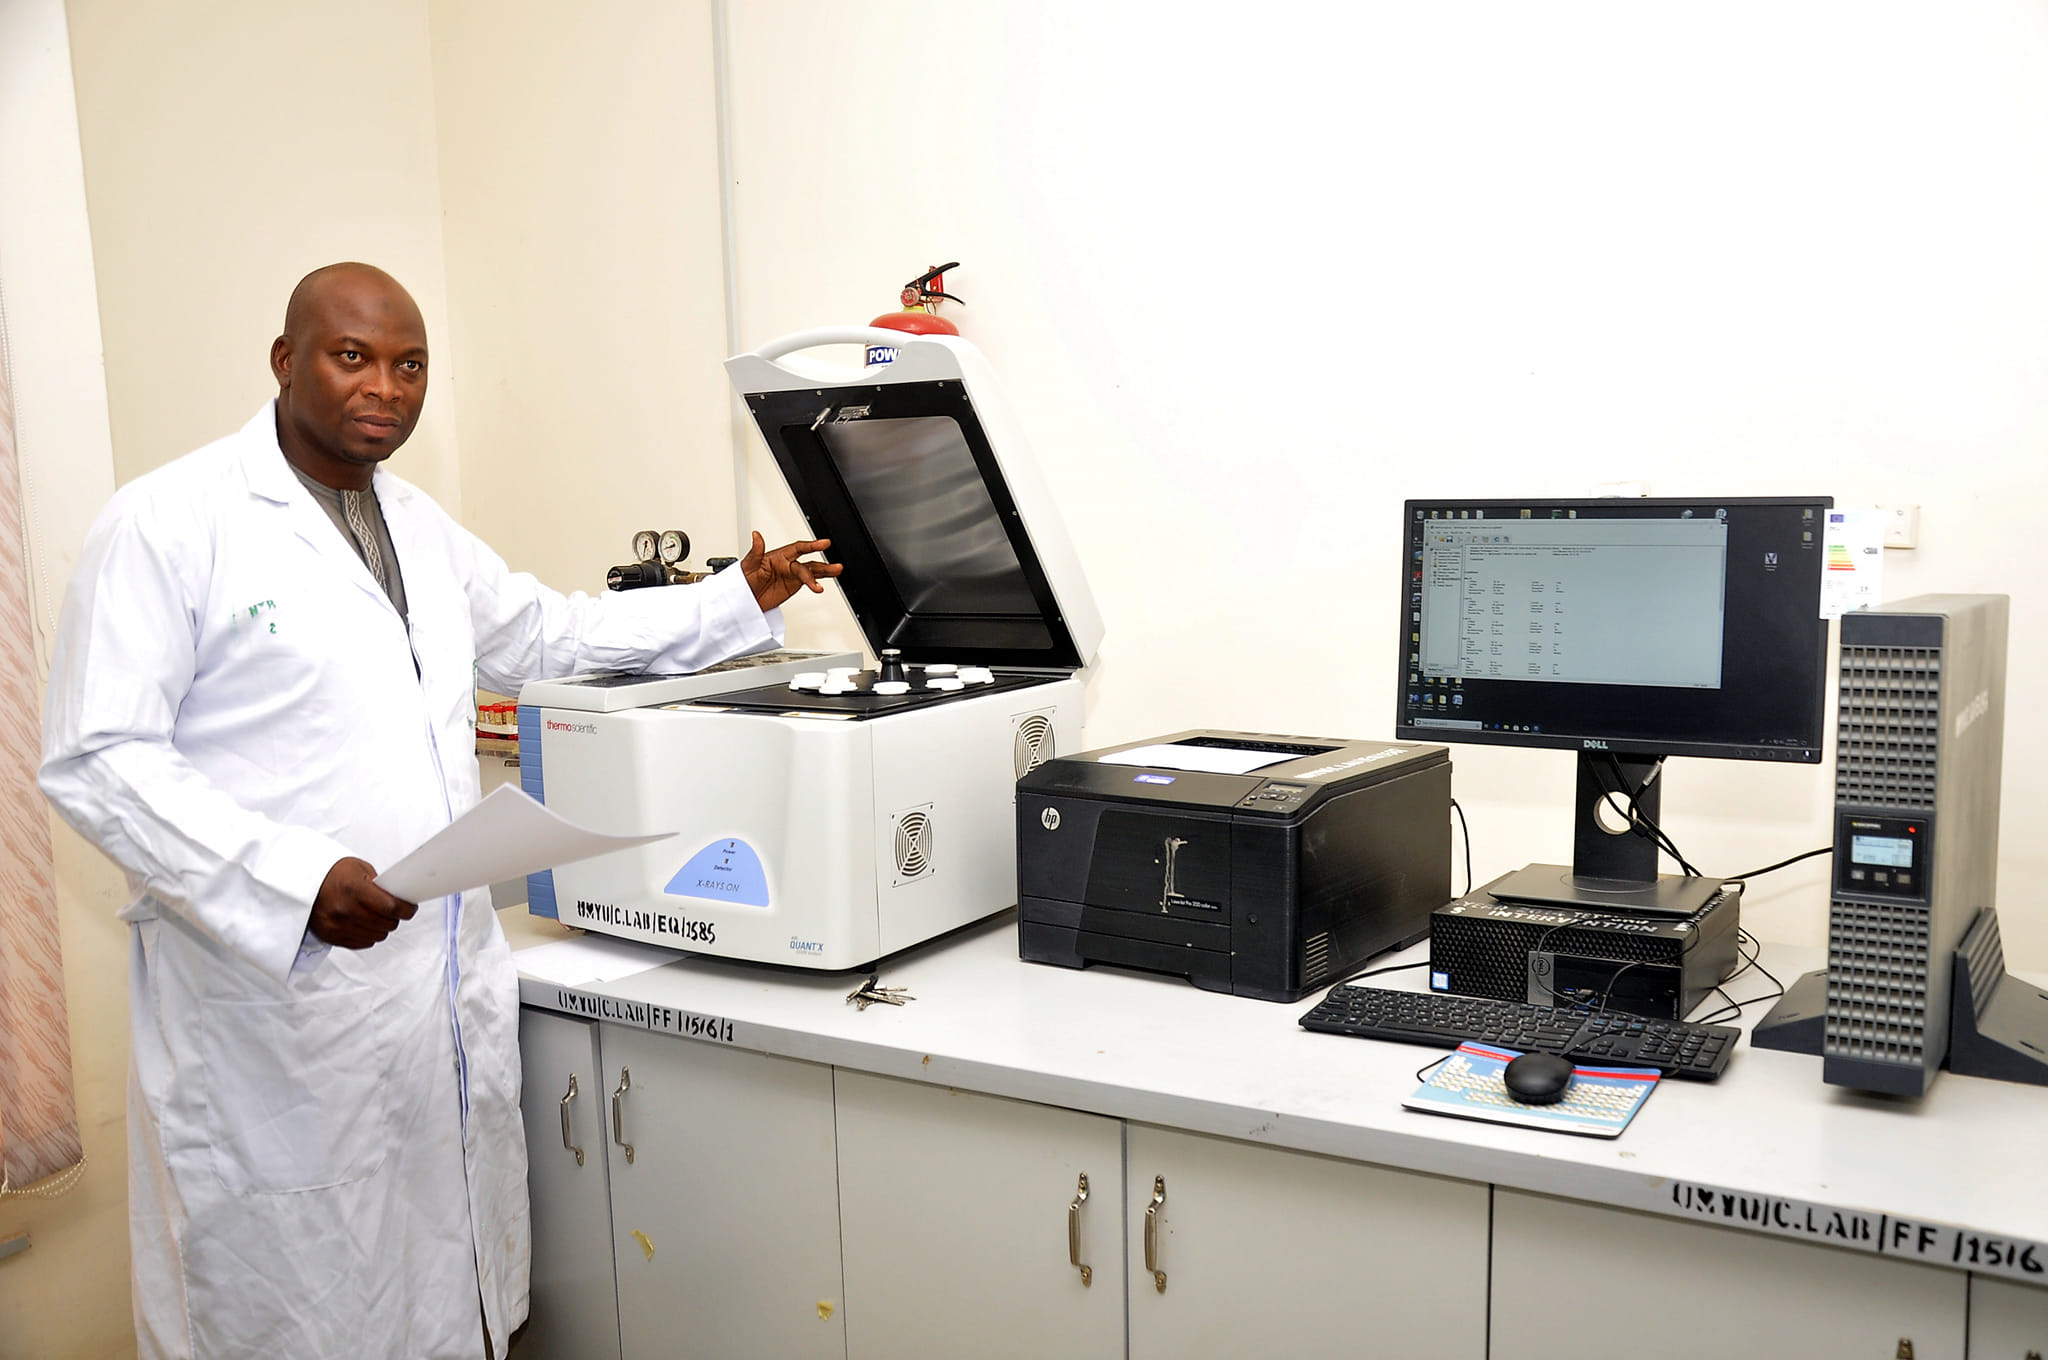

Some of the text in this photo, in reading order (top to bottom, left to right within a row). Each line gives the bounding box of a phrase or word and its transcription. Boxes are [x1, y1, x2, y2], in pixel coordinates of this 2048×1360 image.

[869, 348, 902, 363] POW
[1583, 739, 1609, 749] DELL
[1045, 807, 1057, 830] hp
[696, 879, 740, 892] X-RAYS ON
